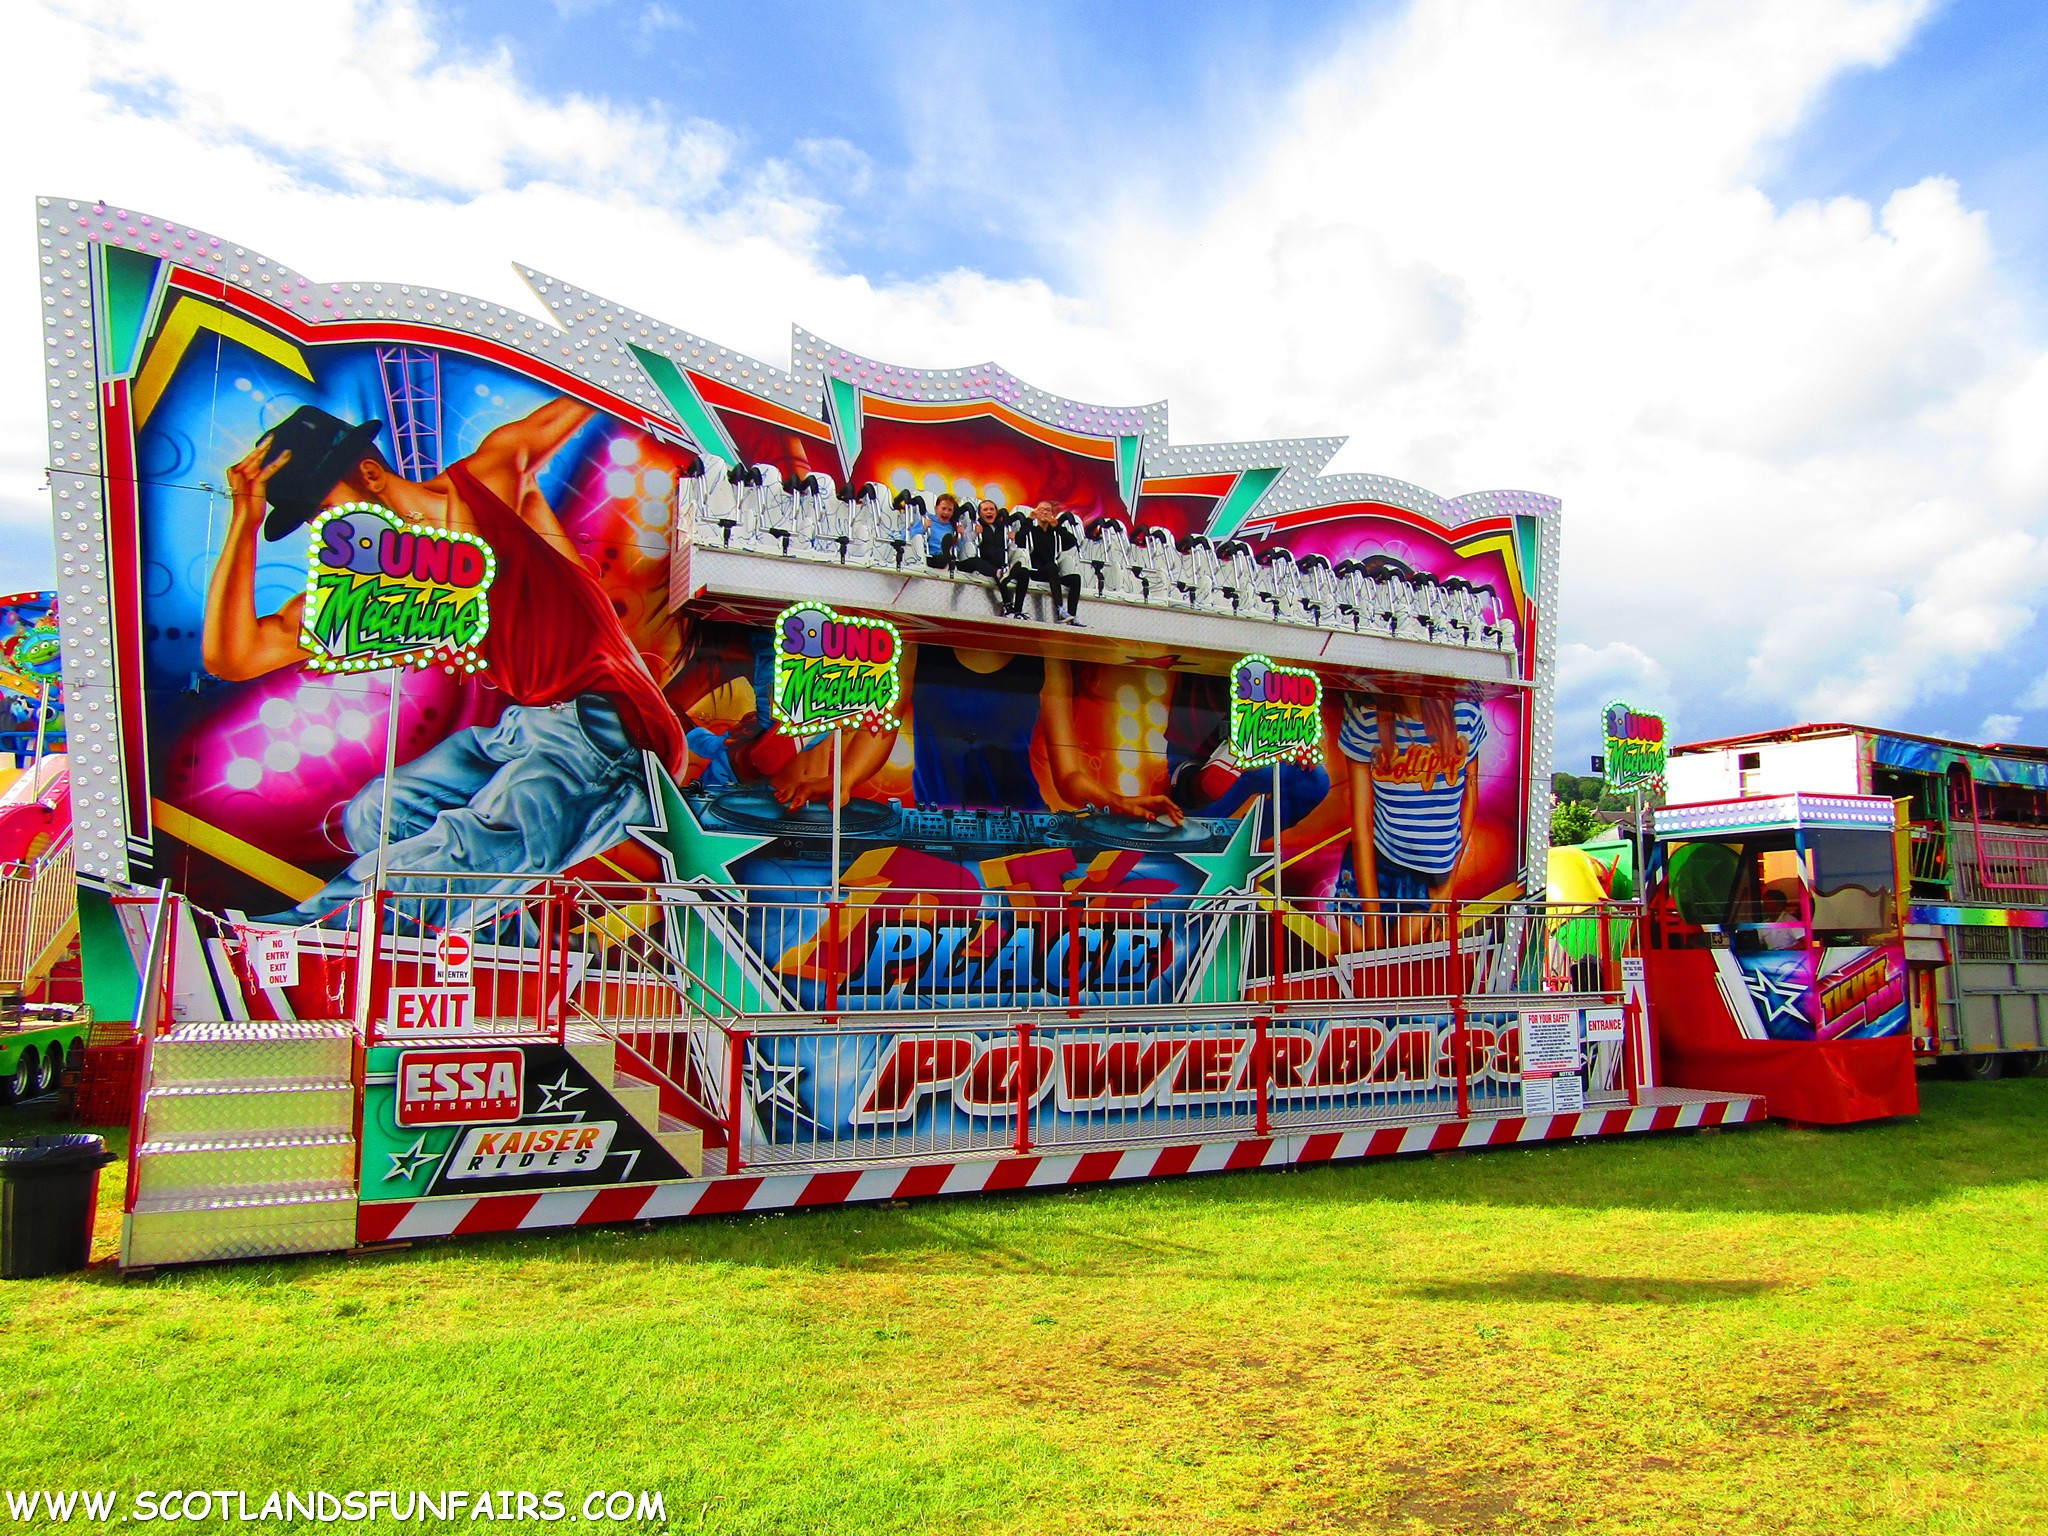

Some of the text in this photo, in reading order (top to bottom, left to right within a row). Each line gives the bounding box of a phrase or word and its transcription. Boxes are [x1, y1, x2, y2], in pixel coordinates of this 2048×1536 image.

[318, 511, 487, 588] SOUND
[314, 573, 480, 656] Machine
[782, 609, 895, 665] SOUND
[780, 658, 893, 723] Machine
[1236, 661, 1317, 706] SOUND
[1236, 703, 1317, 757] Machine
[1606, 704, 1664, 742] SOUND
[1606, 740, 1665, 786] Machine
[265, 951, 290, 961] ENTRY
[272, 939, 283, 948] NO
[845, 922, 1168, 995] PLACE
[269, 963, 287, 972] EXIT
[269, 975, 288, 984] ONLY
[447, 970, 469, 979] ENTRY
[1821, 957, 1887, 1026] TICKET
[396, 993, 469, 1029] EXIT
[1528, 1013, 1570, 1024] FOR YOUR SAFETY
[1588, 1019, 1622, 1031] ENTRANCE
[405, 1062, 517, 1102] ESSA
[404, 1100, 517, 1112] AIRBRUSH
[466, 1149, 591, 1171] RIDES
[475, 1127, 601, 1156] KAISER
